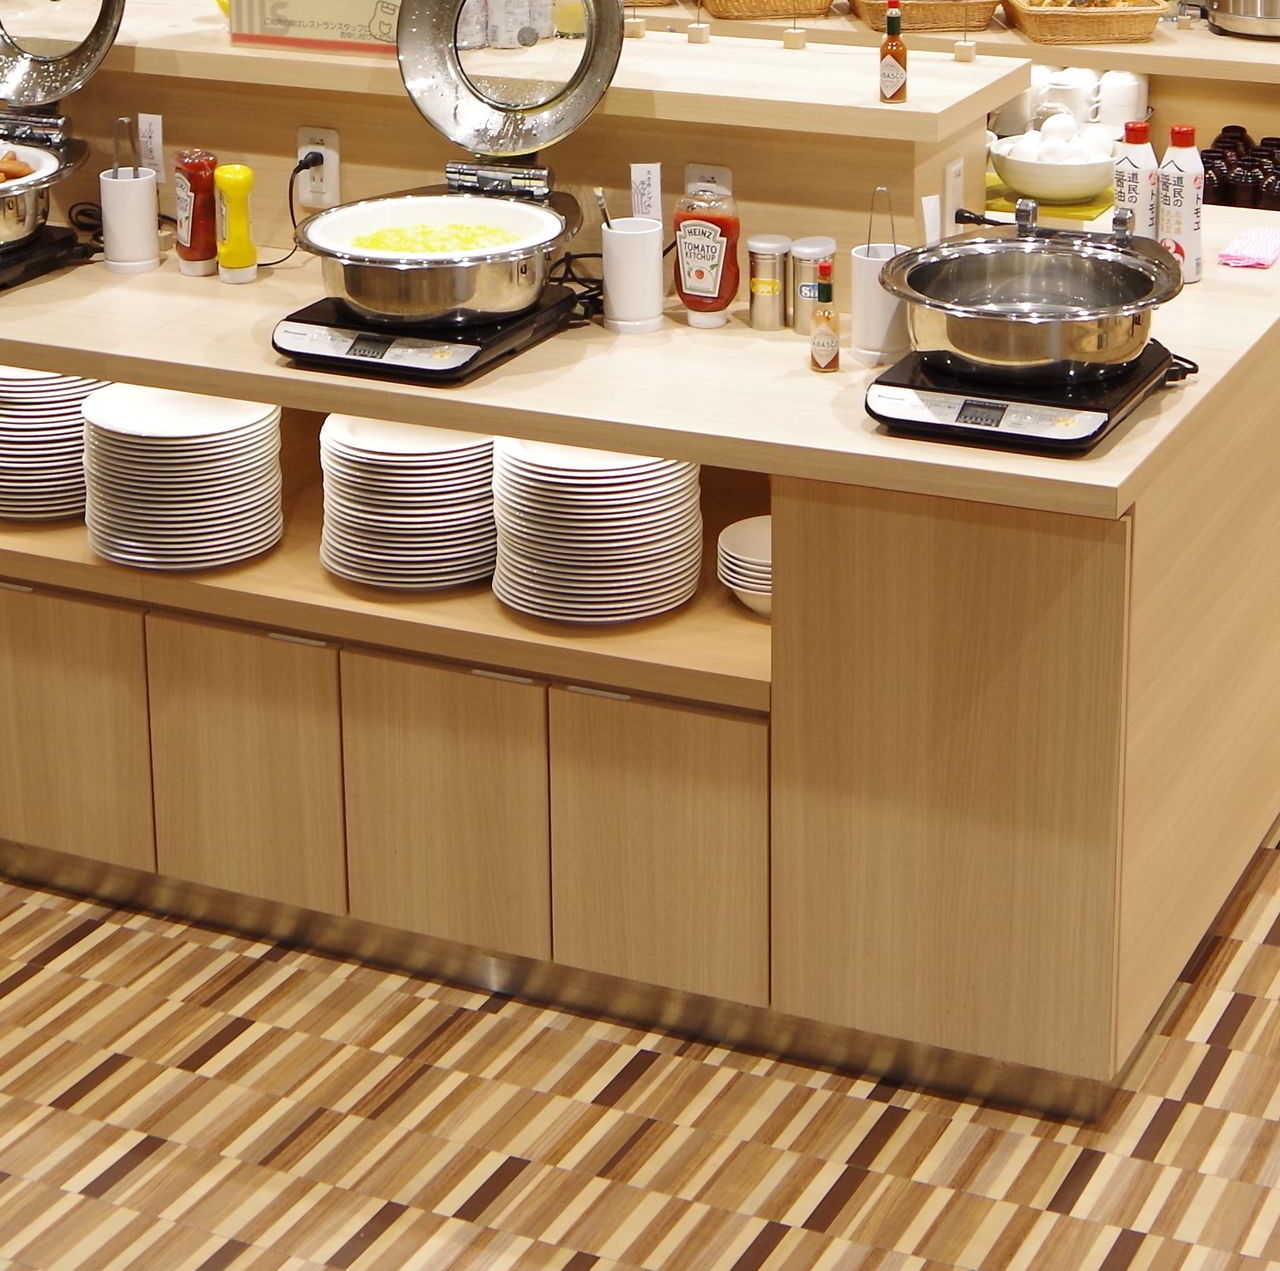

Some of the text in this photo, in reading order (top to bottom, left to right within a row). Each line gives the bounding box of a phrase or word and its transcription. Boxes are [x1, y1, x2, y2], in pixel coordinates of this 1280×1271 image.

[1127, 172, 1139, 204] 道民の
[1172, 176, 1184, 208] 道民の
[687, 228, 713, 239] HEINZ
[683, 241, 717, 255] TOMATO
[685, 251, 716, 261] KETCHUP
